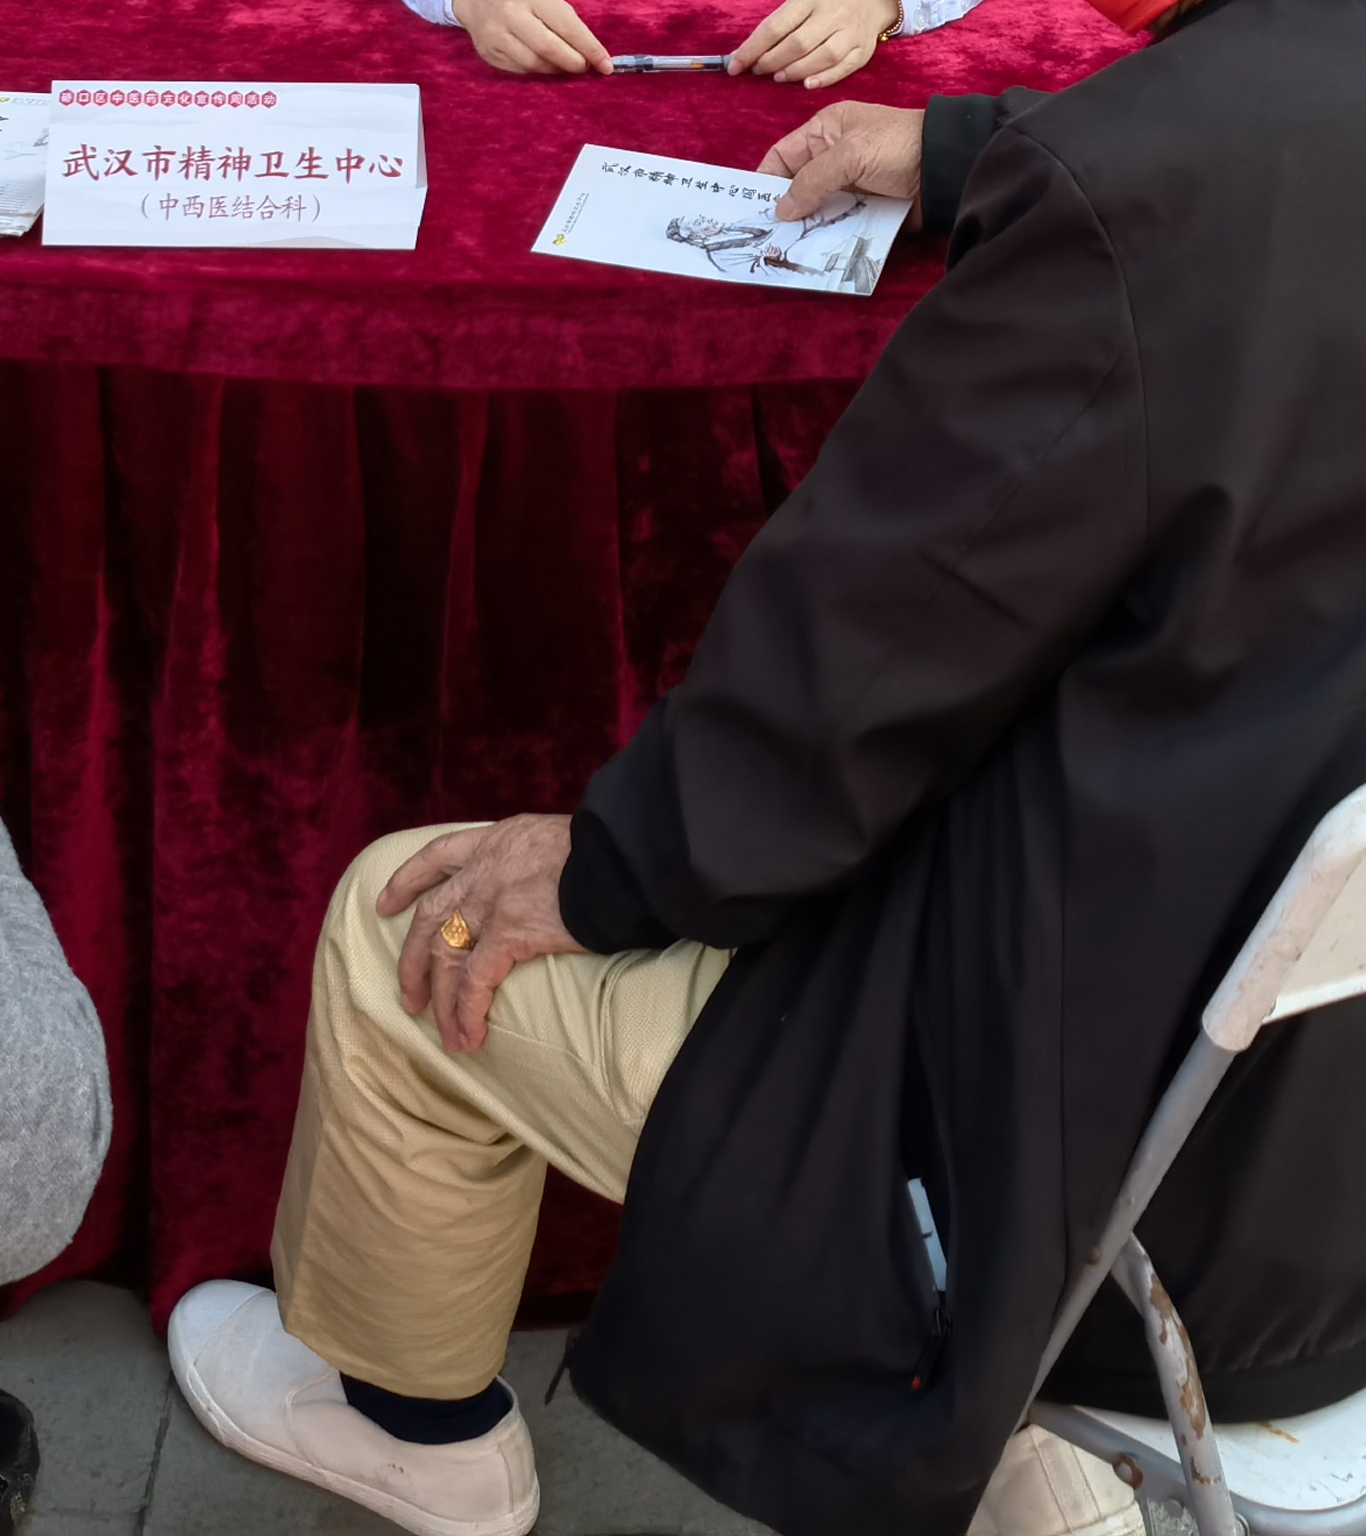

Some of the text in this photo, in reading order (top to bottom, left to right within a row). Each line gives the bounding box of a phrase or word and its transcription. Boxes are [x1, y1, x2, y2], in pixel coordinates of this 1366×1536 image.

[62, 143, 404, 184] 武汉市精神卫生中心
